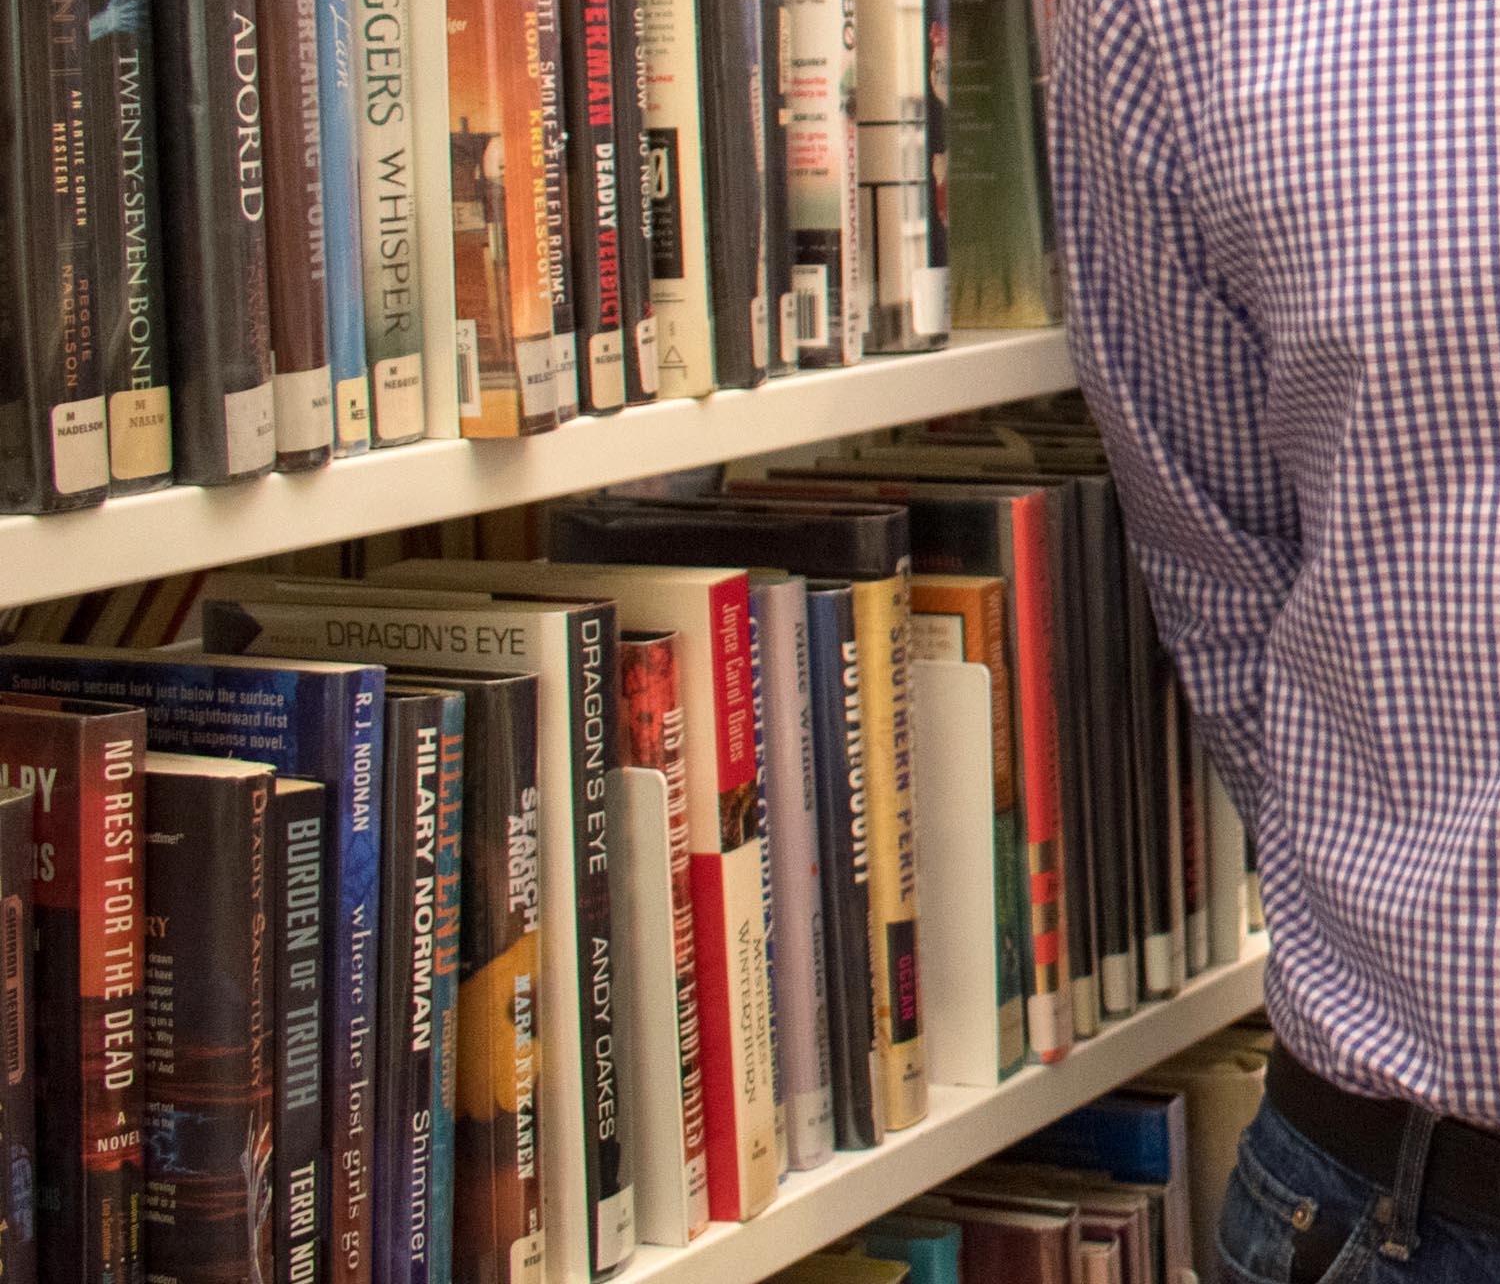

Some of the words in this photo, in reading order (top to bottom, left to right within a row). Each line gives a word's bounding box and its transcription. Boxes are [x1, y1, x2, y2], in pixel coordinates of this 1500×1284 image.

[525, 11, 541, 80] ROAD
[72, 115, 85, 167] ARTIE
[232, 11, 265, 223] ADORED
[528, 109, 545, 170] KRIS
[52, 121, 69, 196] MYSTERY
[118, 49, 149, 286] TWENTY-SEVEN
[594, 141, 617, 228] DEADLY
[74, 172, 88, 228] COHEN
[304, 181, 327, 281] POINT
[378, 146, 412, 338] WHISPER
[532, 178, 552, 301] NELSCOTT
[548, 234, 567, 304] ROOMS
[598, 227, 620, 327] VERDICT
[62, 264, 78, 390] NADELSON
[78, 277, 92, 363] REGGIE
[325, 619, 468, 653] DRAGON'S
[475, 626, 527, 656] EYE
[721, 603, 744, 652] Joyce
[218, 687, 237, 704] the
[239, 691, 285, 708] surface
[264, 710, 288, 729] first
[580, 617, 606, 804] DRAGON'S
[723, 655, 745, 710] Carol
[889, 622, 913, 791] SOUTHERN
[104, 739, 134, 782] NO
[250, 732, 288, 750] novel.
[351, 742, 373, 833] NOONAN
[414, 726, 439, 864] HILARY
[104, 791, 135, 866] REST
[586, 812, 608, 875] EYE
[896, 806, 916, 900] PERIL
[105, 878, 134, 935] FOR
[286, 816, 321, 953] BURDEN
[105, 941, 134, 1001] THE
[289, 958, 317, 992] OF
[350, 904, 373, 1006] where
[411, 876, 437, 1054] NORMAN
[590, 936, 613, 1032] ANDY
[349, 1015, 371, 1070] the
[514, 974, 534, 1041] MARK
[105, 1007, 134, 1092] DEAD
[286, 998, 321, 1112] TRUTH
[116, 1111, 126, 1126] A
[347, 1079, 371, 1141] lost
[516, 1050, 536, 1181] NYKANEN
[595, 1034, 617, 1142] OAKES
[97, 1129, 141, 1154] NOVEL
[289, 1158, 316, 1239] TERRI
[341, 1149, 369, 1221] girls
[408, 1108, 432, 1266] Shimmer
[341, 1231, 361, 1271] go
